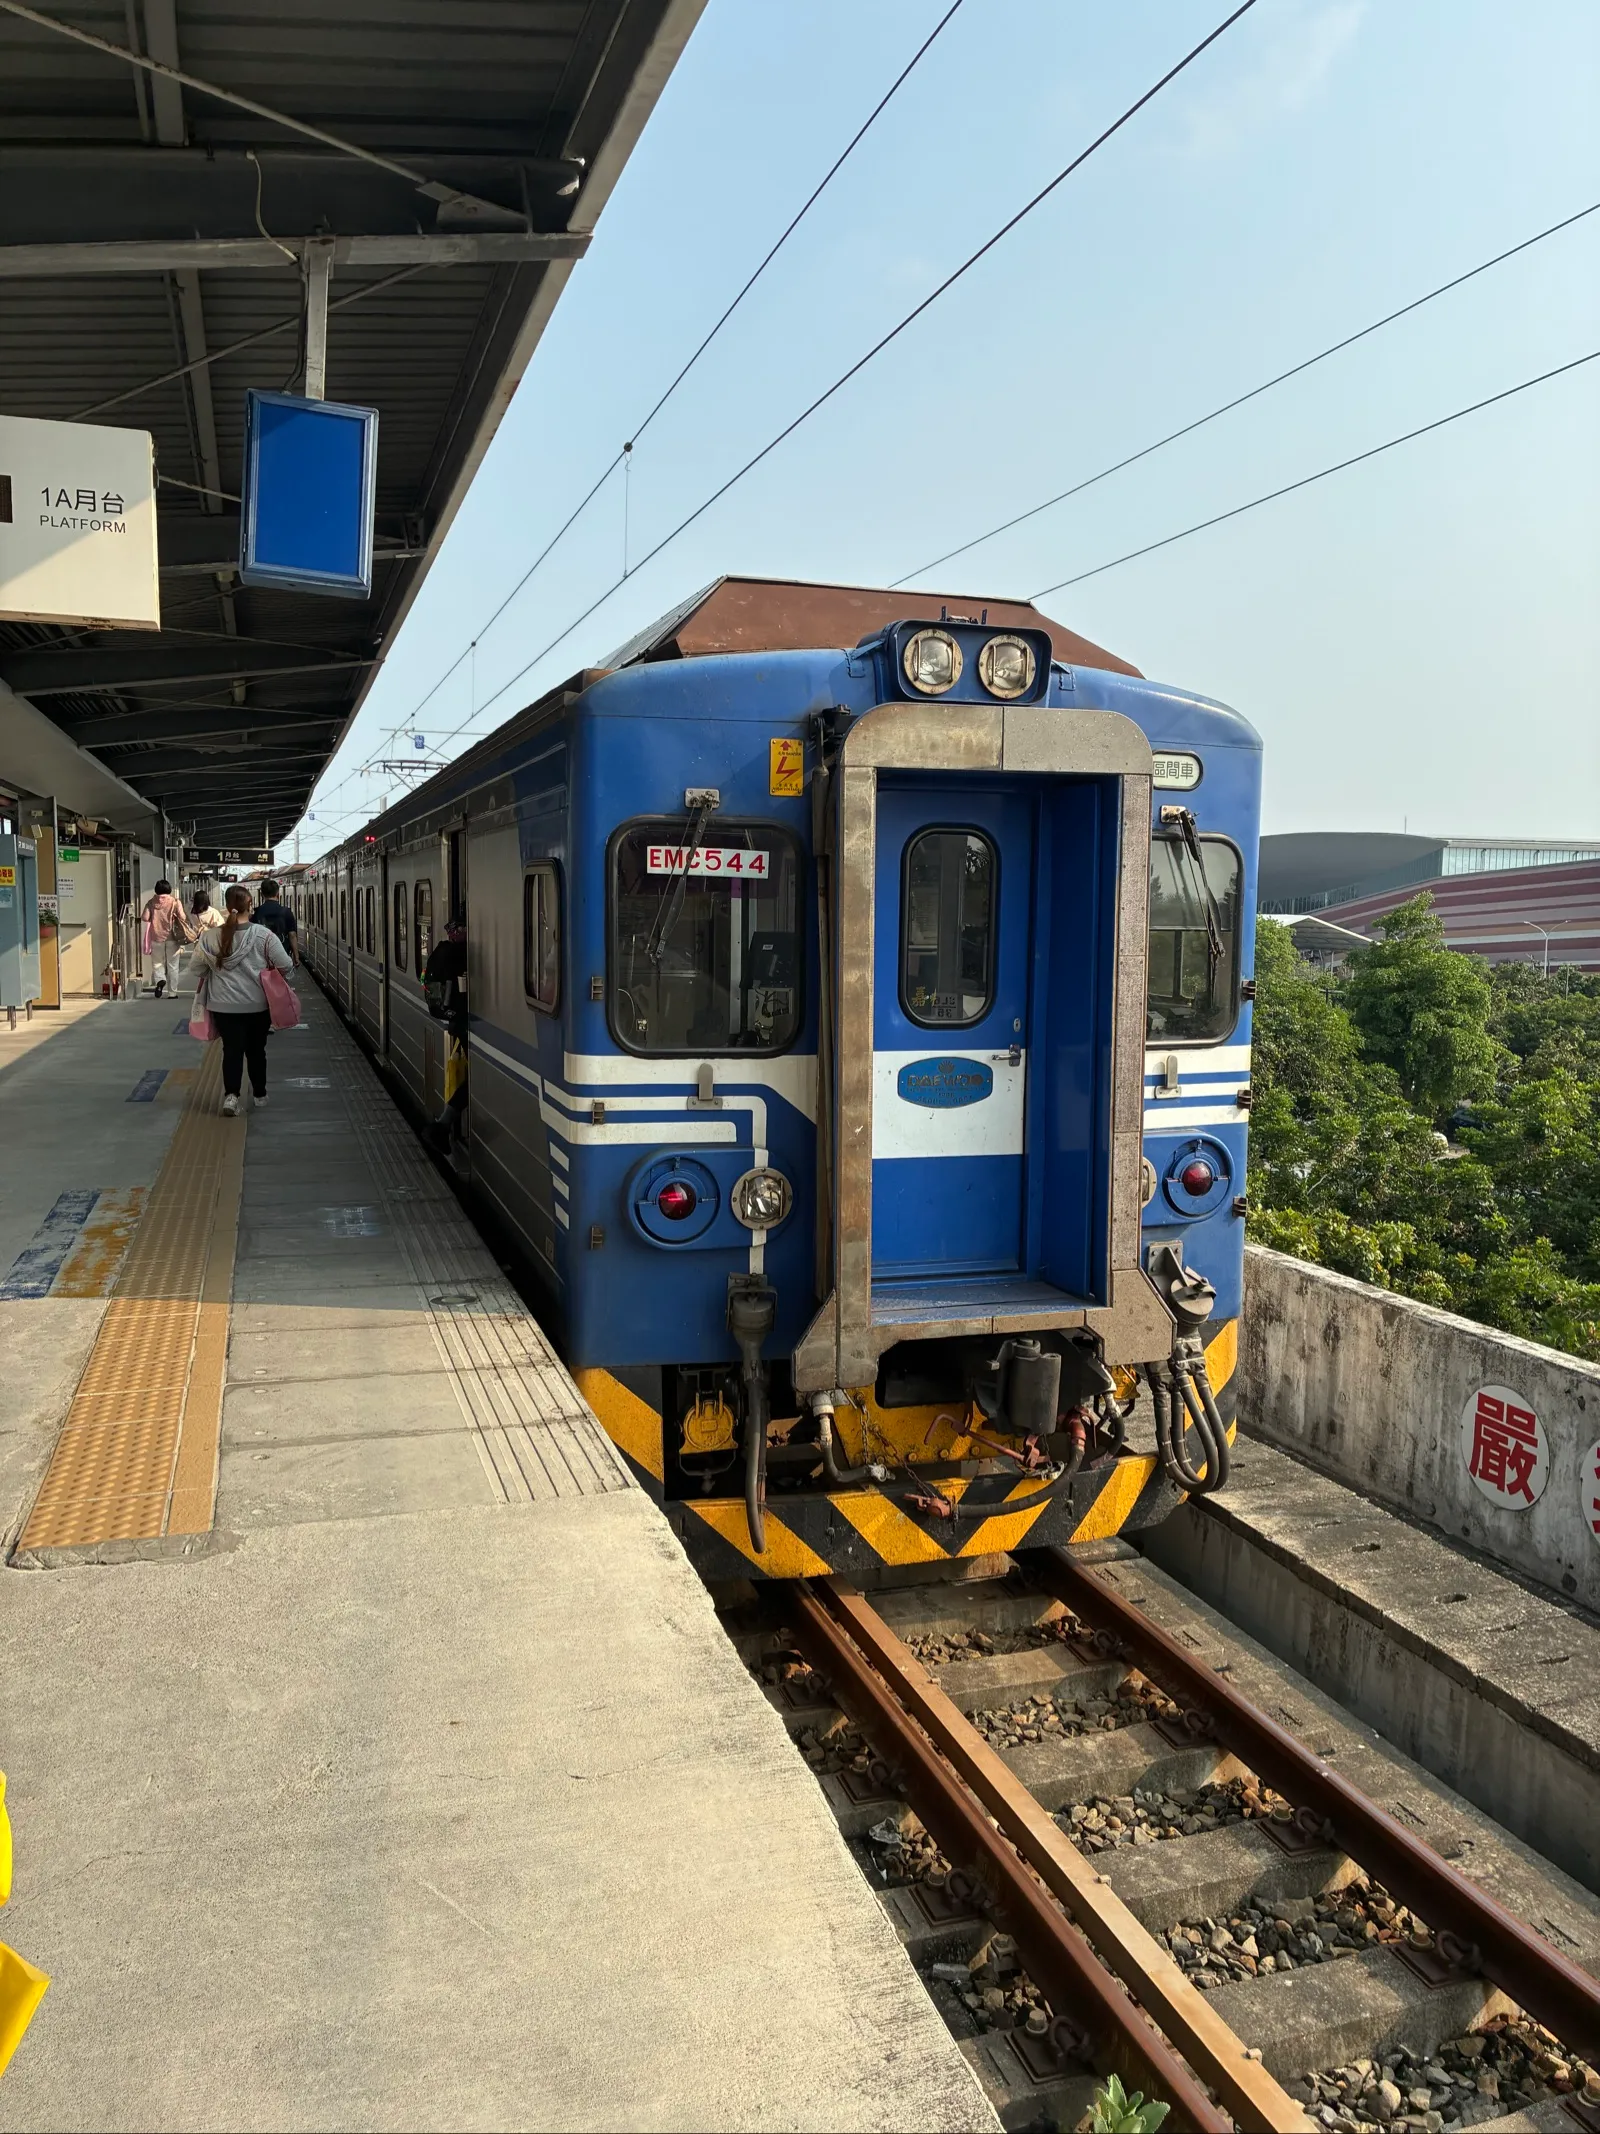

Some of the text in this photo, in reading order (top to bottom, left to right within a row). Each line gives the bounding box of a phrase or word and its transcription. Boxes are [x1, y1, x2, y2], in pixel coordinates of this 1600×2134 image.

[41, 486, 125, 515] 1A月台
[40, 515, 126, 534] PLATFORM
[1153, 761, 1194, 779] 區間車
[649, 847, 766, 874] EMC544
[1469, 1392, 1539, 1504] 嚴
